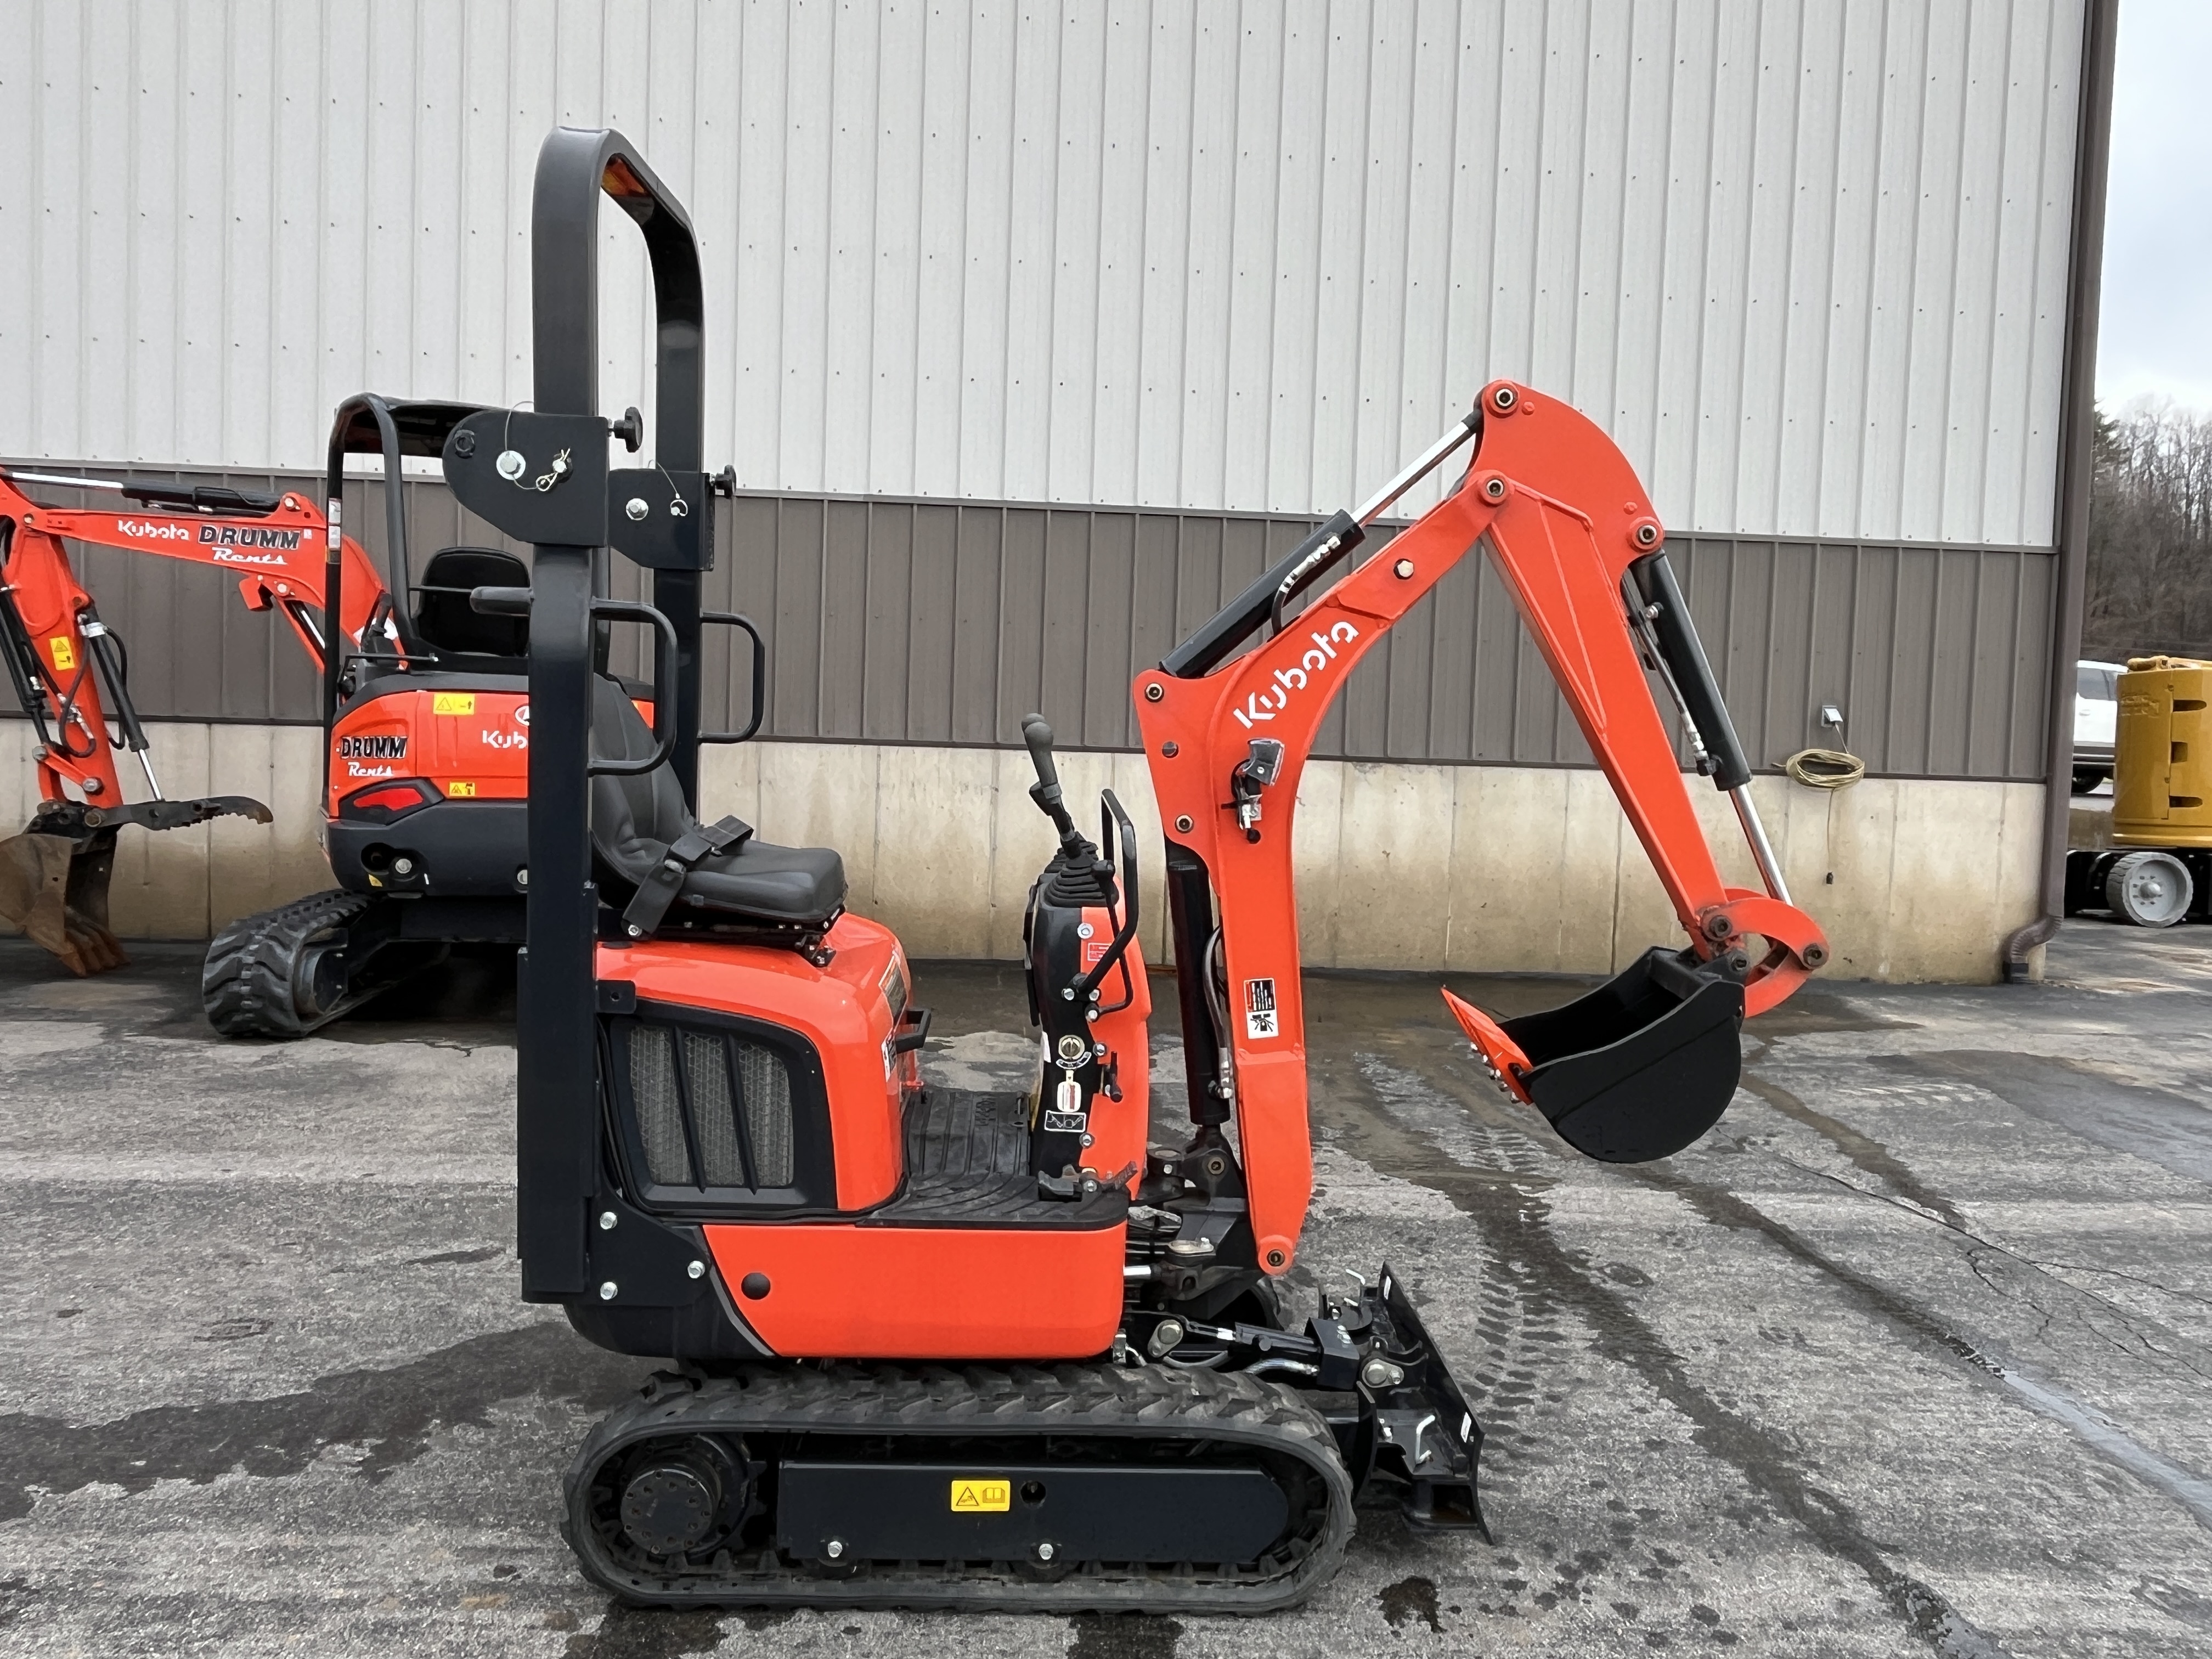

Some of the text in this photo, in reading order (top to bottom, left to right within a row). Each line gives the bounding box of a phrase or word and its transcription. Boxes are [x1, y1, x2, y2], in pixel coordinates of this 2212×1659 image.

[117, 520, 189, 540] Kubota
[198, 524, 300, 550] DRUMM
[212, 547, 289, 565] Rents
[1233, 621, 1359, 729] Kubota
[341, 736, 408, 759] DRUMM
[482, 730, 528, 749] Kub
[348, 761, 394, 776] Rents
